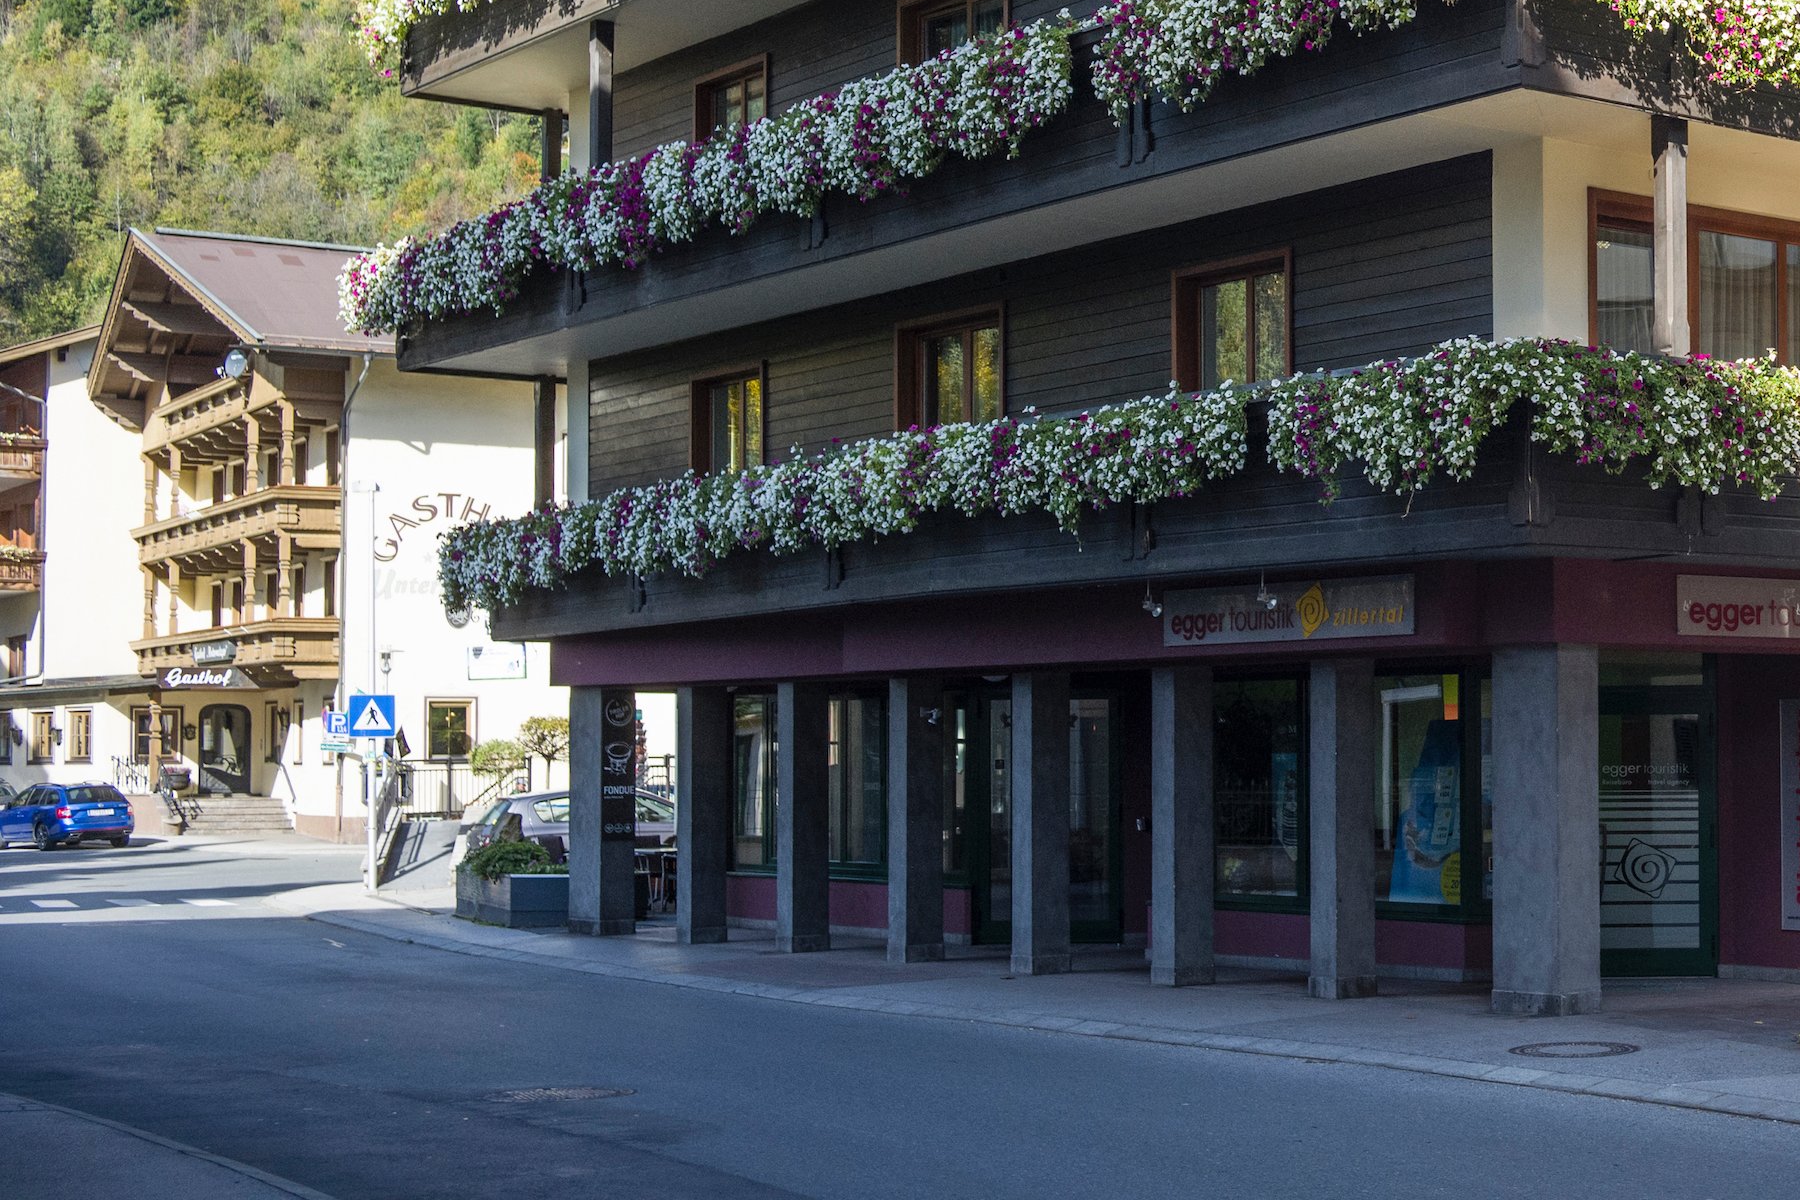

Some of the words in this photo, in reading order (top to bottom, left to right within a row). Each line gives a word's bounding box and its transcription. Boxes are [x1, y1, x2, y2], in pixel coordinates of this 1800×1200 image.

[374, 492, 491, 562] GASTH
[374, 569, 440, 599] Unter
[1170, 611, 1226, 641] egger
[1228, 604, 1295, 633] touristik
[1332, 605, 1405, 628] zillertal
[1688, 601, 1764, 632] egger
[164, 667, 233, 688] Gasthof
[1602, 763, 1642, 778] egger
[1643, 762, 1690, 775] touristik
[603, 785, 635, 795] FONDUE
